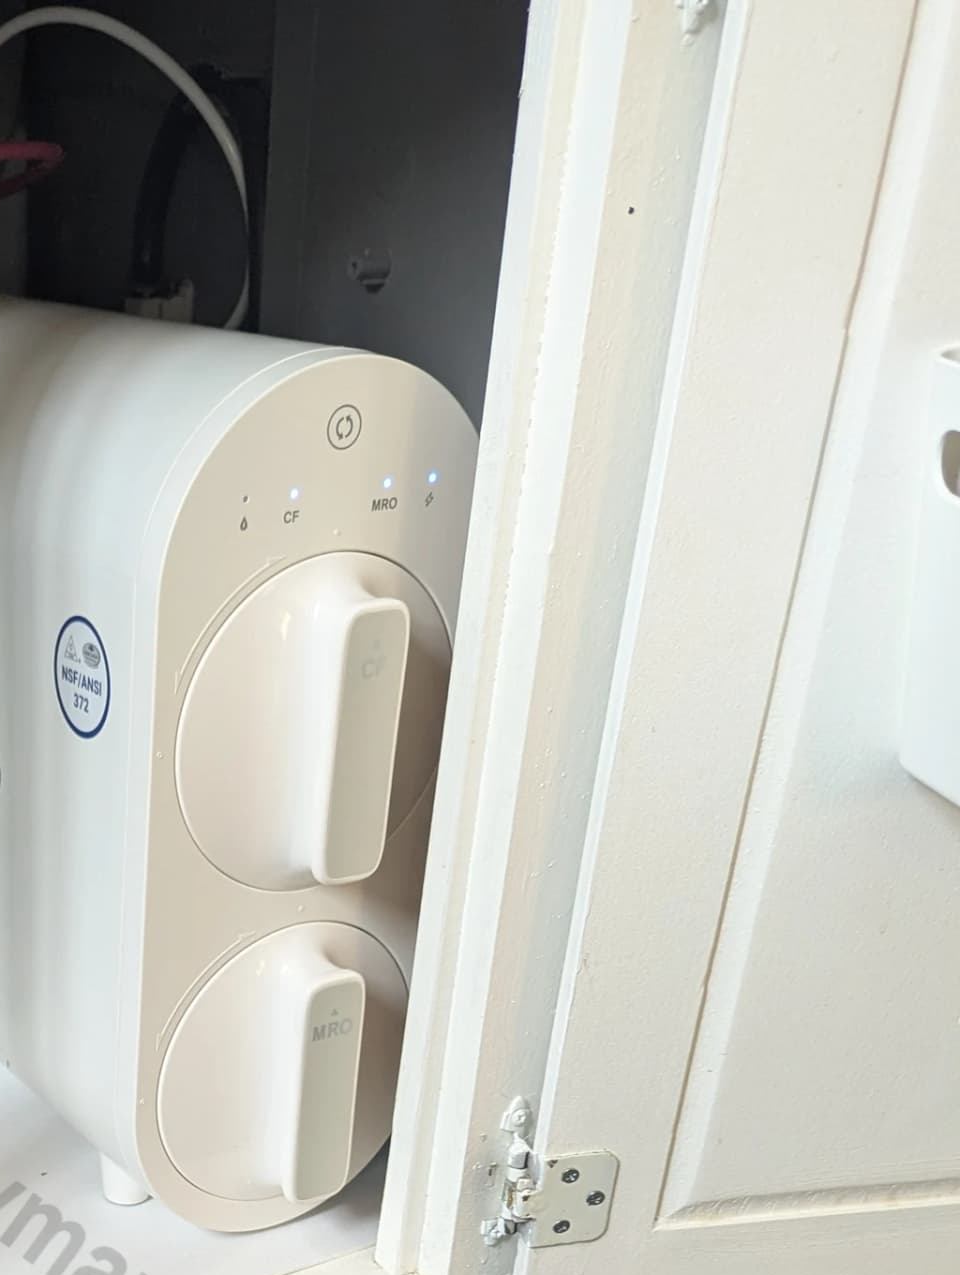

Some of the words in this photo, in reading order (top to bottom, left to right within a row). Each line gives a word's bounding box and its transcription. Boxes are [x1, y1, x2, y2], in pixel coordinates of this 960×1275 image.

[371, 496, 398, 512] MRO
[283, 510, 300, 525] CF
[61, 664, 102, 697] NSF/ANSI
[73, 692, 89, 714] 372
[311, 1018, 353, 1042] MRO
